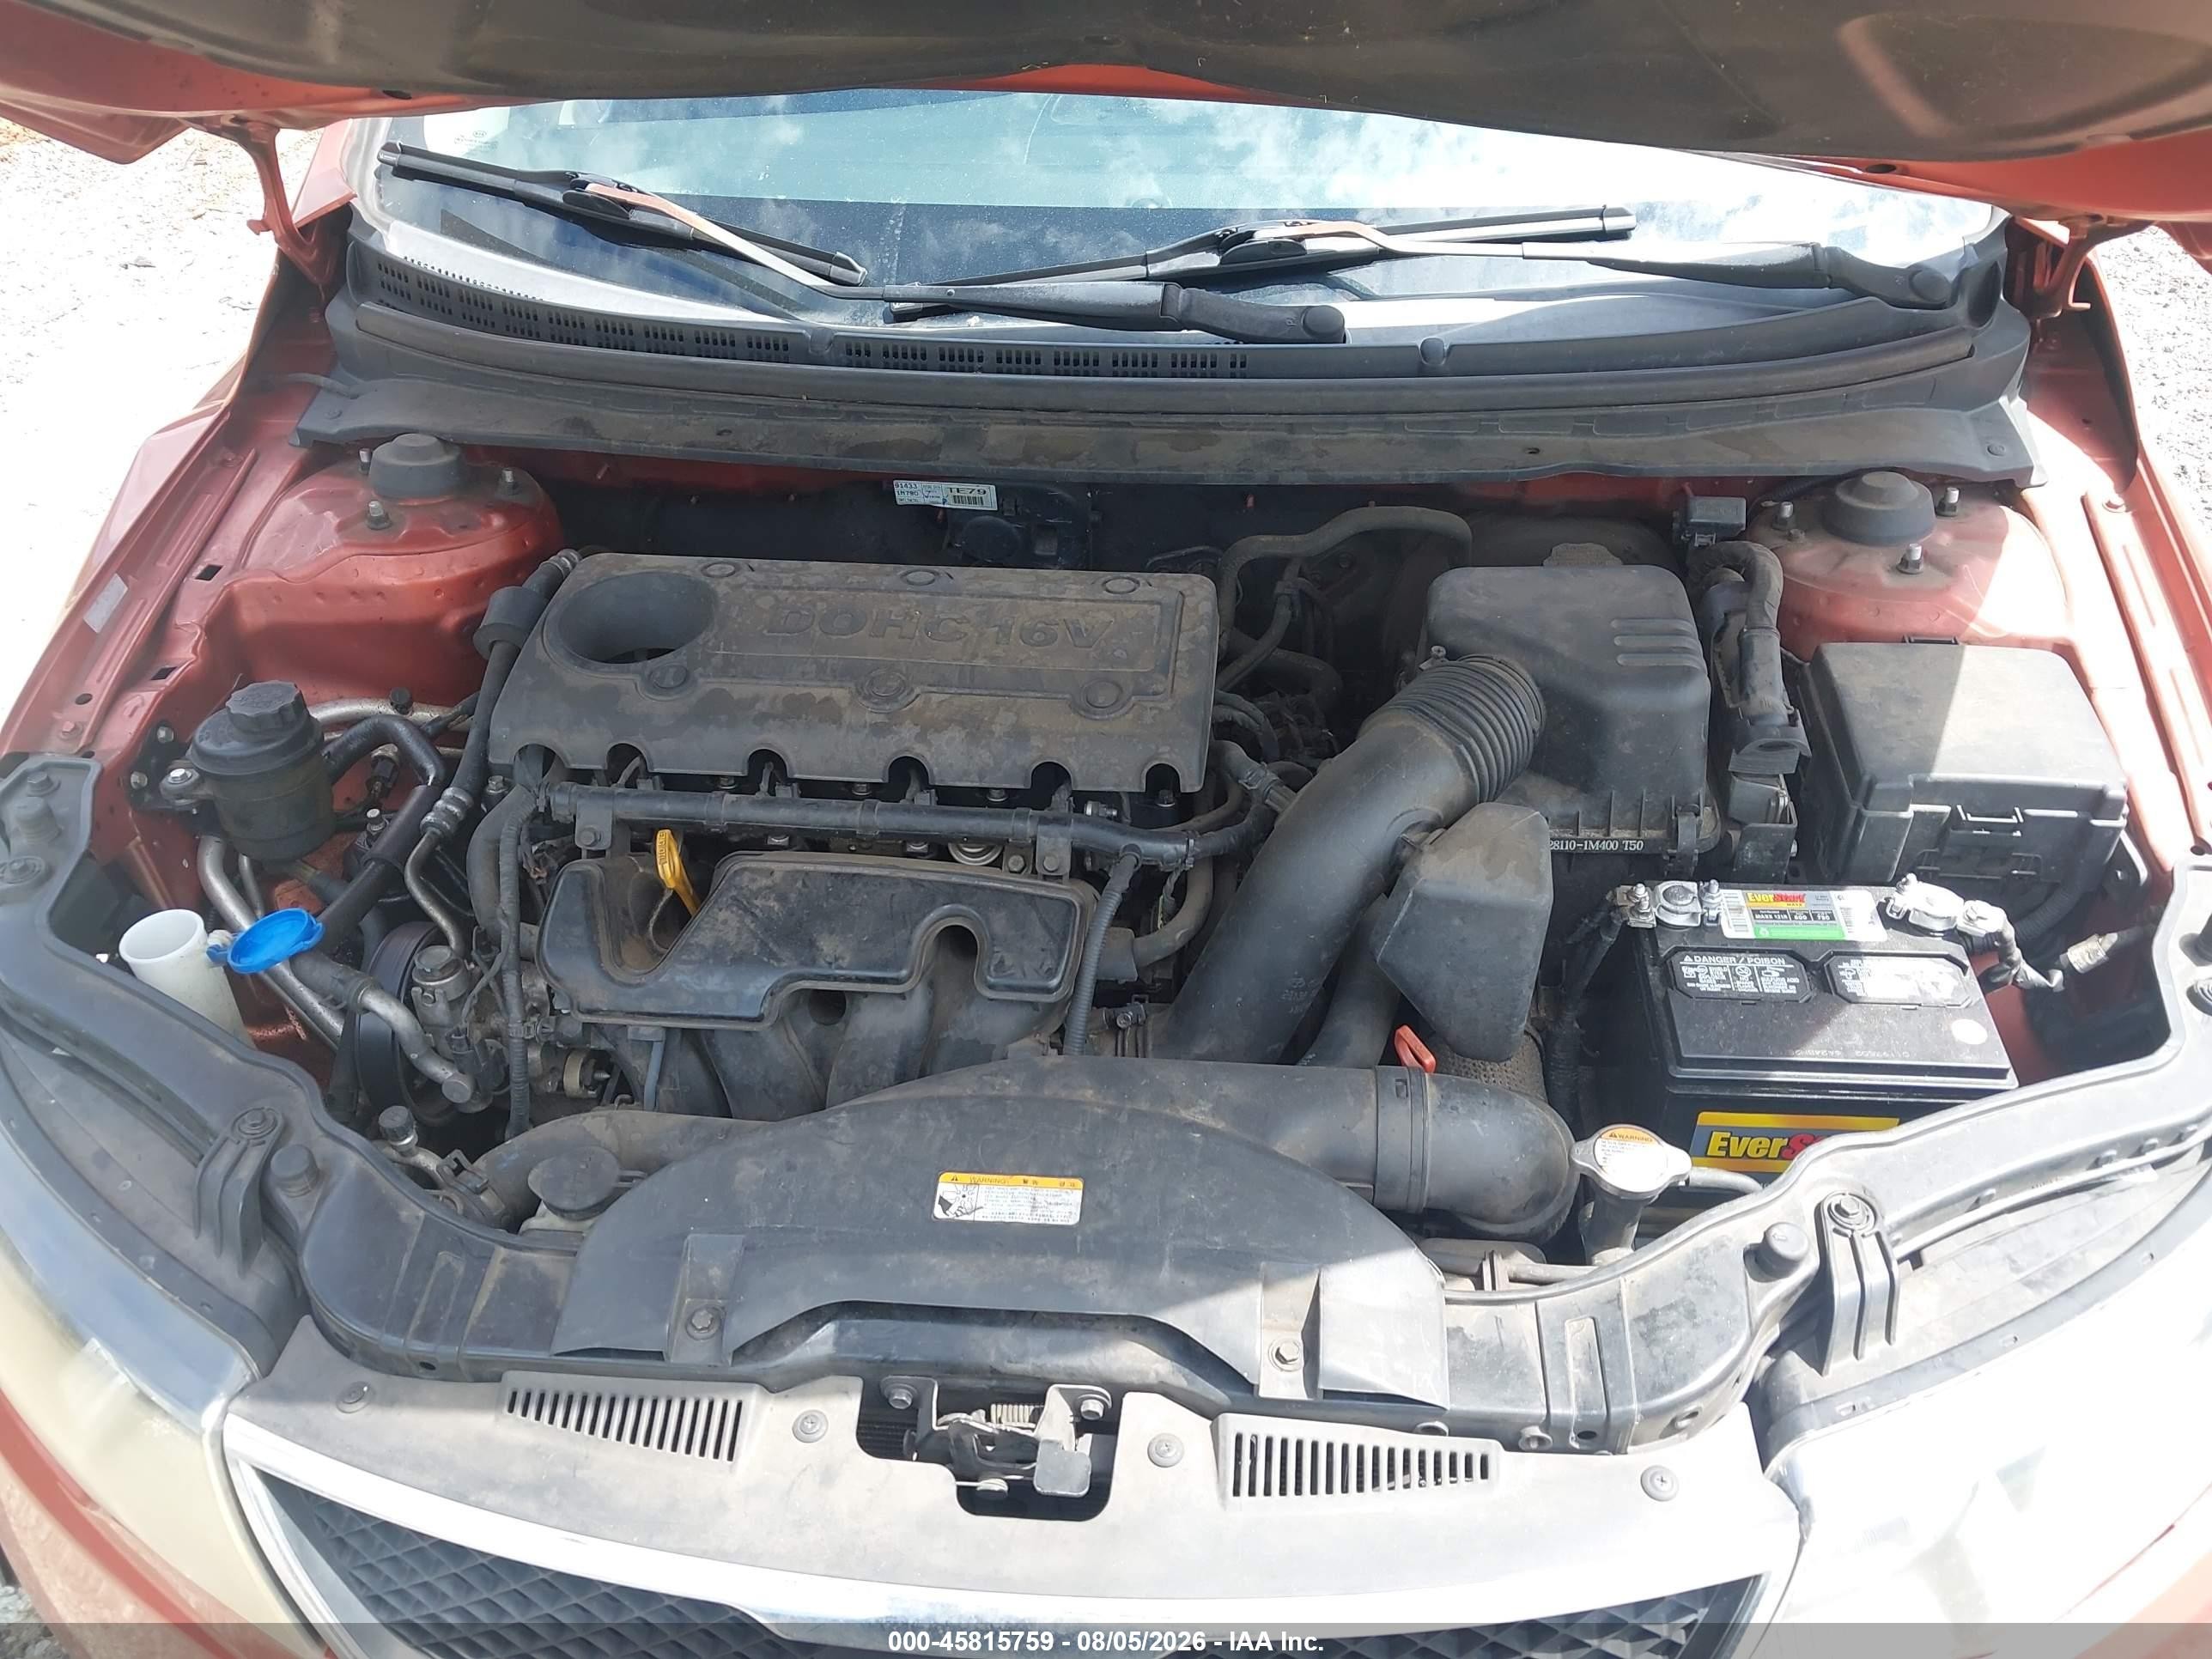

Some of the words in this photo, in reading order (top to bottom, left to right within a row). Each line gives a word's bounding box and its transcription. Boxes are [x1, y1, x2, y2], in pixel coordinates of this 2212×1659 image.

[947, 486, 987, 495] TE79
[763, 604, 971, 642] DOHC
[990, 616, 1115, 648] 16V
[1622, 840, 1644, 851] T50
[1693, 955, 1736, 963] DANGER
[1618, 1133, 1654, 1142] WARNING
[1706, 1130, 1827, 1161] EverS
